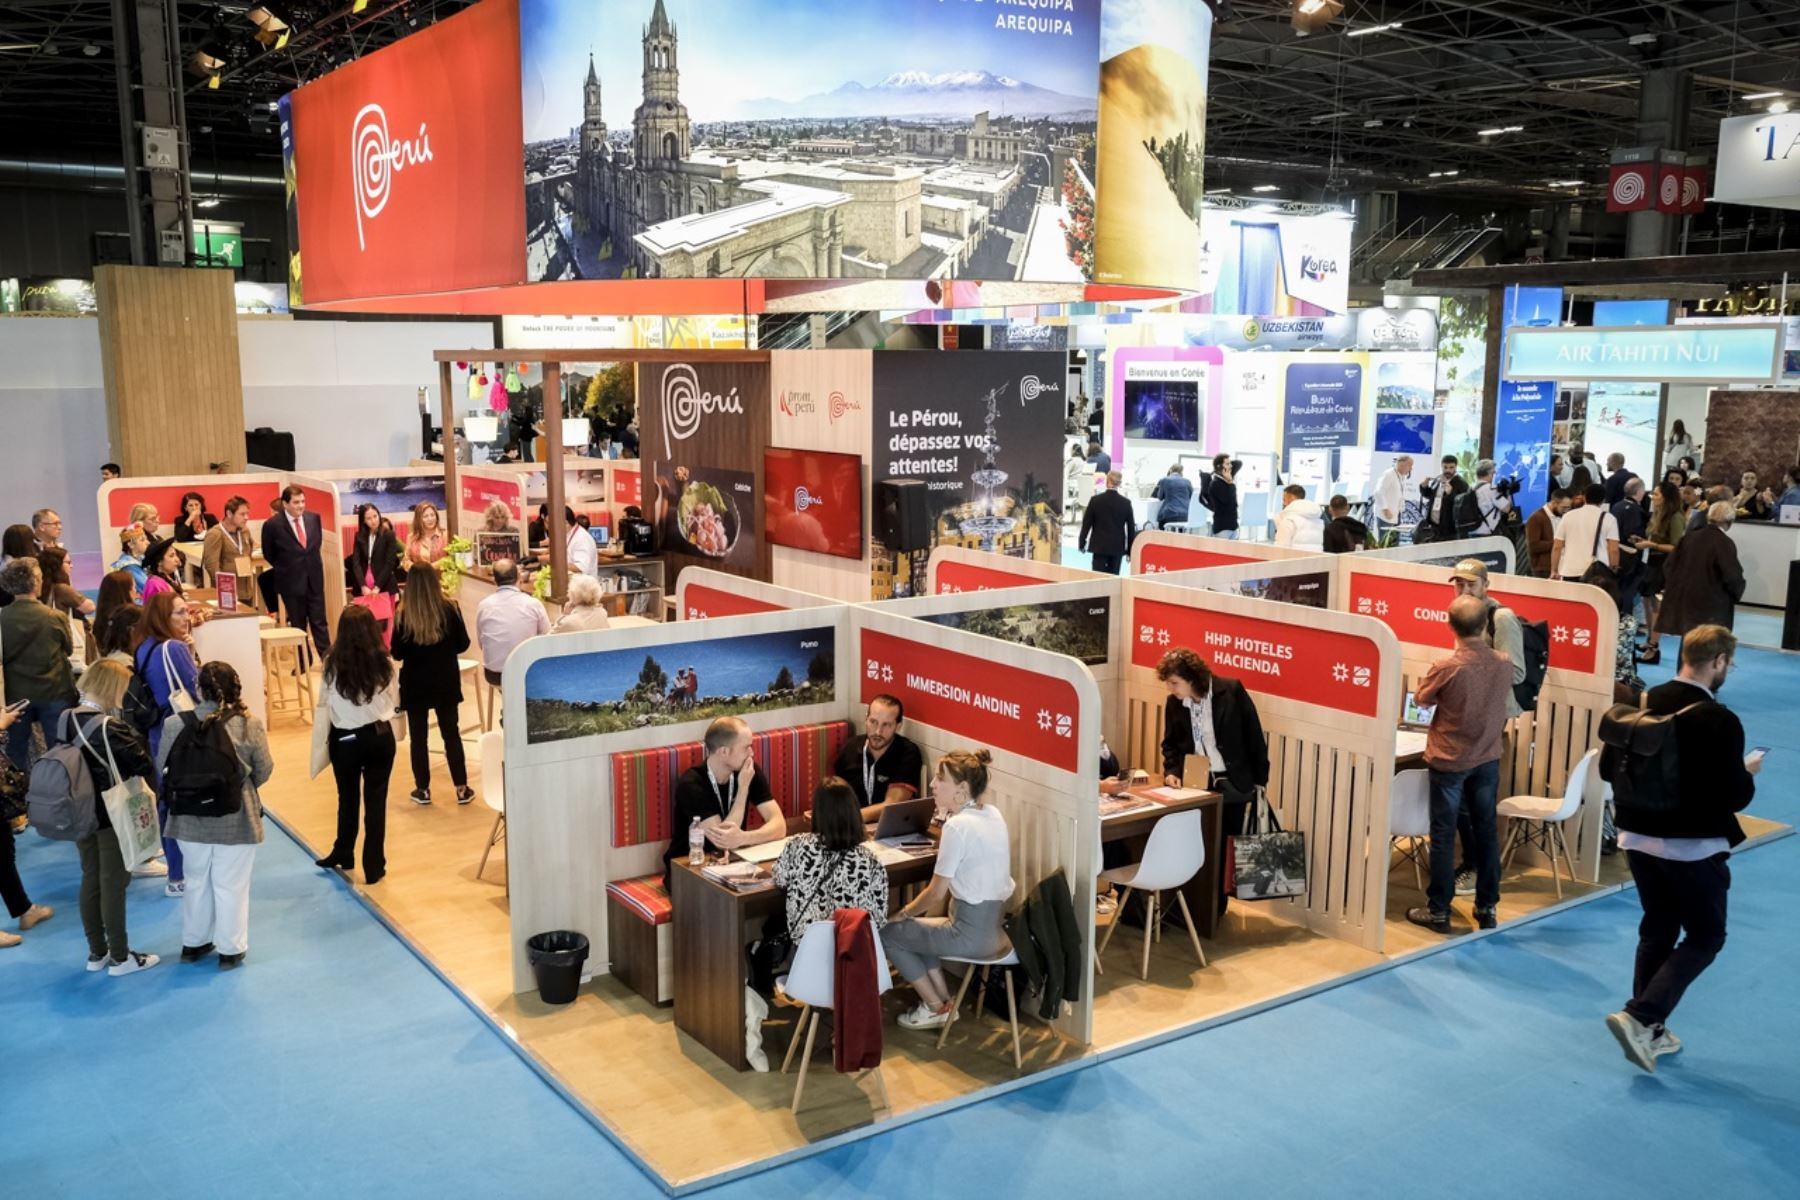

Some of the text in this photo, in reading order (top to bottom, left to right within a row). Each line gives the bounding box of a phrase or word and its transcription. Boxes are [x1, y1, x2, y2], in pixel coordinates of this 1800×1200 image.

[995, 14, 1073, 35] AREQUIPA
[352, 103, 433, 252] Perú
[1300, 255, 1337, 280] Korea
[1262, 321, 1324, 333] UZBEKISTAN
[1297, 333, 1324, 342] airways
[1556, 342, 1720, 363] AIR TAHITI NUI
[1128, 367, 1206, 378] Bienvenue en Corée
[1020, 375, 1059, 407] Perú
[661, 363, 743, 461] Perú
[829, 391, 862, 425] Perú
[889, 409, 963, 428] Le Pérou,
[889, 434, 991, 453] dépassez vos
[889, 456, 959, 475] attentes!
[794, 486, 822, 516] Perú
[1204, 630, 1293, 660] HHP HOTELES
[1213, 650, 1280, 676] HACIENDA
[906, 673, 1020, 720] IMMERSION ANDINE
